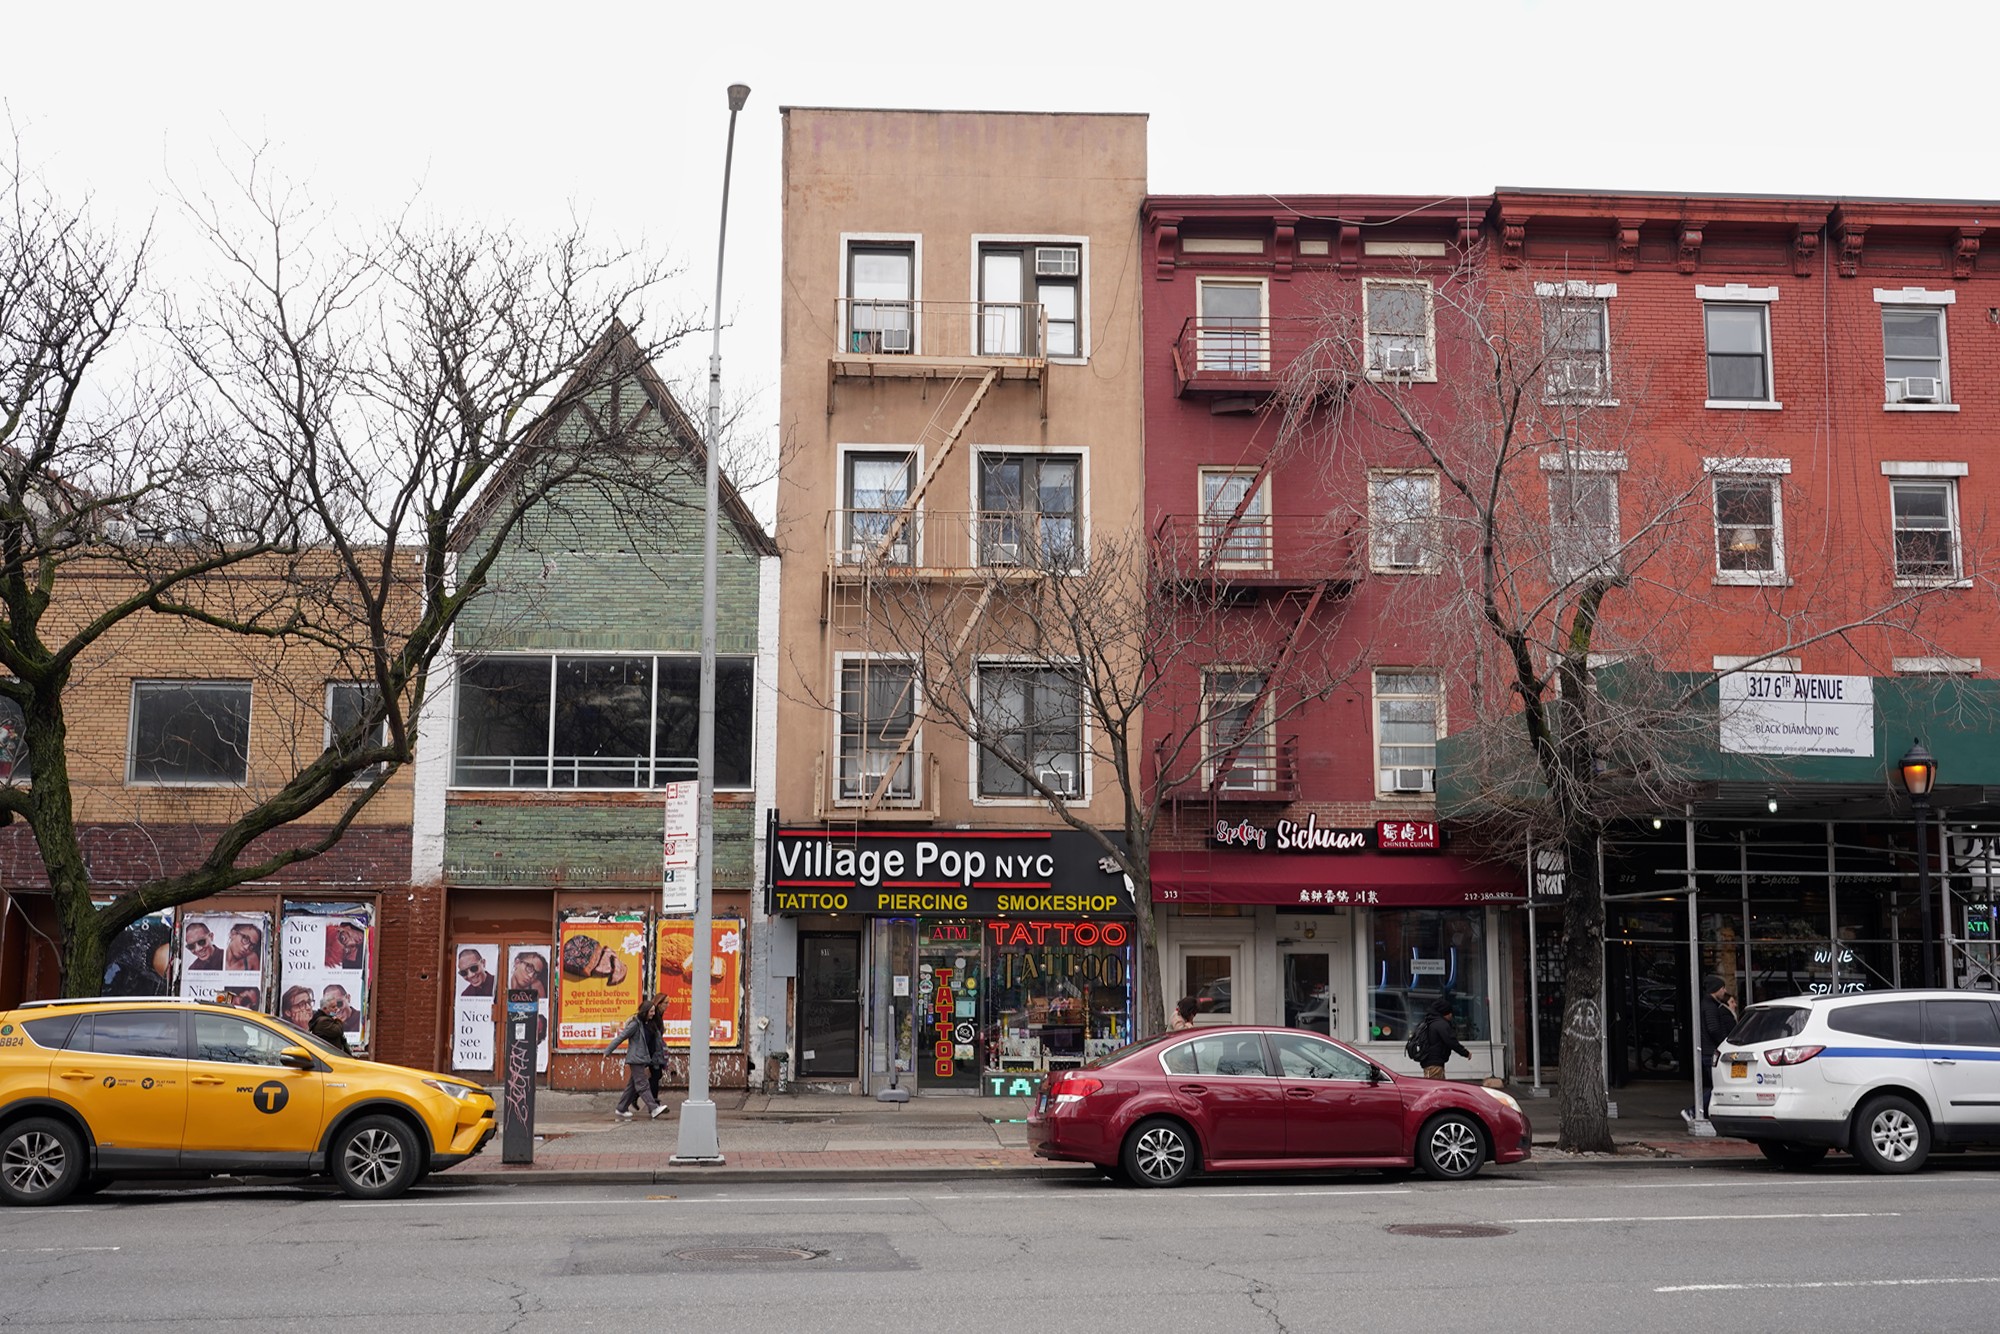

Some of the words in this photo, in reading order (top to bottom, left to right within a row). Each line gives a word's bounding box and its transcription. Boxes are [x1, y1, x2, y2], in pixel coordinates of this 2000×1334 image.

[1750, 677, 1771, 697] 317
[1794, 678, 1843, 700] AVENUE
[1755, 724, 1781, 734] BLACK
[1782, 725, 1823, 735] DIAMOND
[1825, 726, 1839, 736] INC
[1216, 818, 1268, 850] Spicy
[1277, 813, 1366, 850] Sichuan
[777, 840, 905, 887] Village
[916, 841, 986, 887] Pop
[996, 854, 1054, 879] NYC
[1760, 873, 1801, 887] Spirits
[1164, 890, 1178, 899] 313
[776, 893, 848, 910] TATTOO
[878, 894, 968, 910] PIERCING
[997, 894, 1118, 911] SMOKESHOP
[290, 921, 318, 932] Nice
[1294, 920, 1318, 931] 313
[289, 934, 302, 944] to
[932, 926, 968, 940] ATM
[988, 922, 1127, 946] TATTOO
[288, 948, 310, 958] see
[1000, 952, 1123, 990] TATTOO
[571, 990, 586, 999] Get
[1809, 983, 1865, 995] SPIITS
[461, 1011, 489, 1022] Nice
[934, 967, 954, 1077] TATTOO
[461, 1024, 473, 1035] to
[562, 1028, 597, 1038] meati
[460, 1039, 481, 1047] see
[262, 1086, 282, 1111] T
